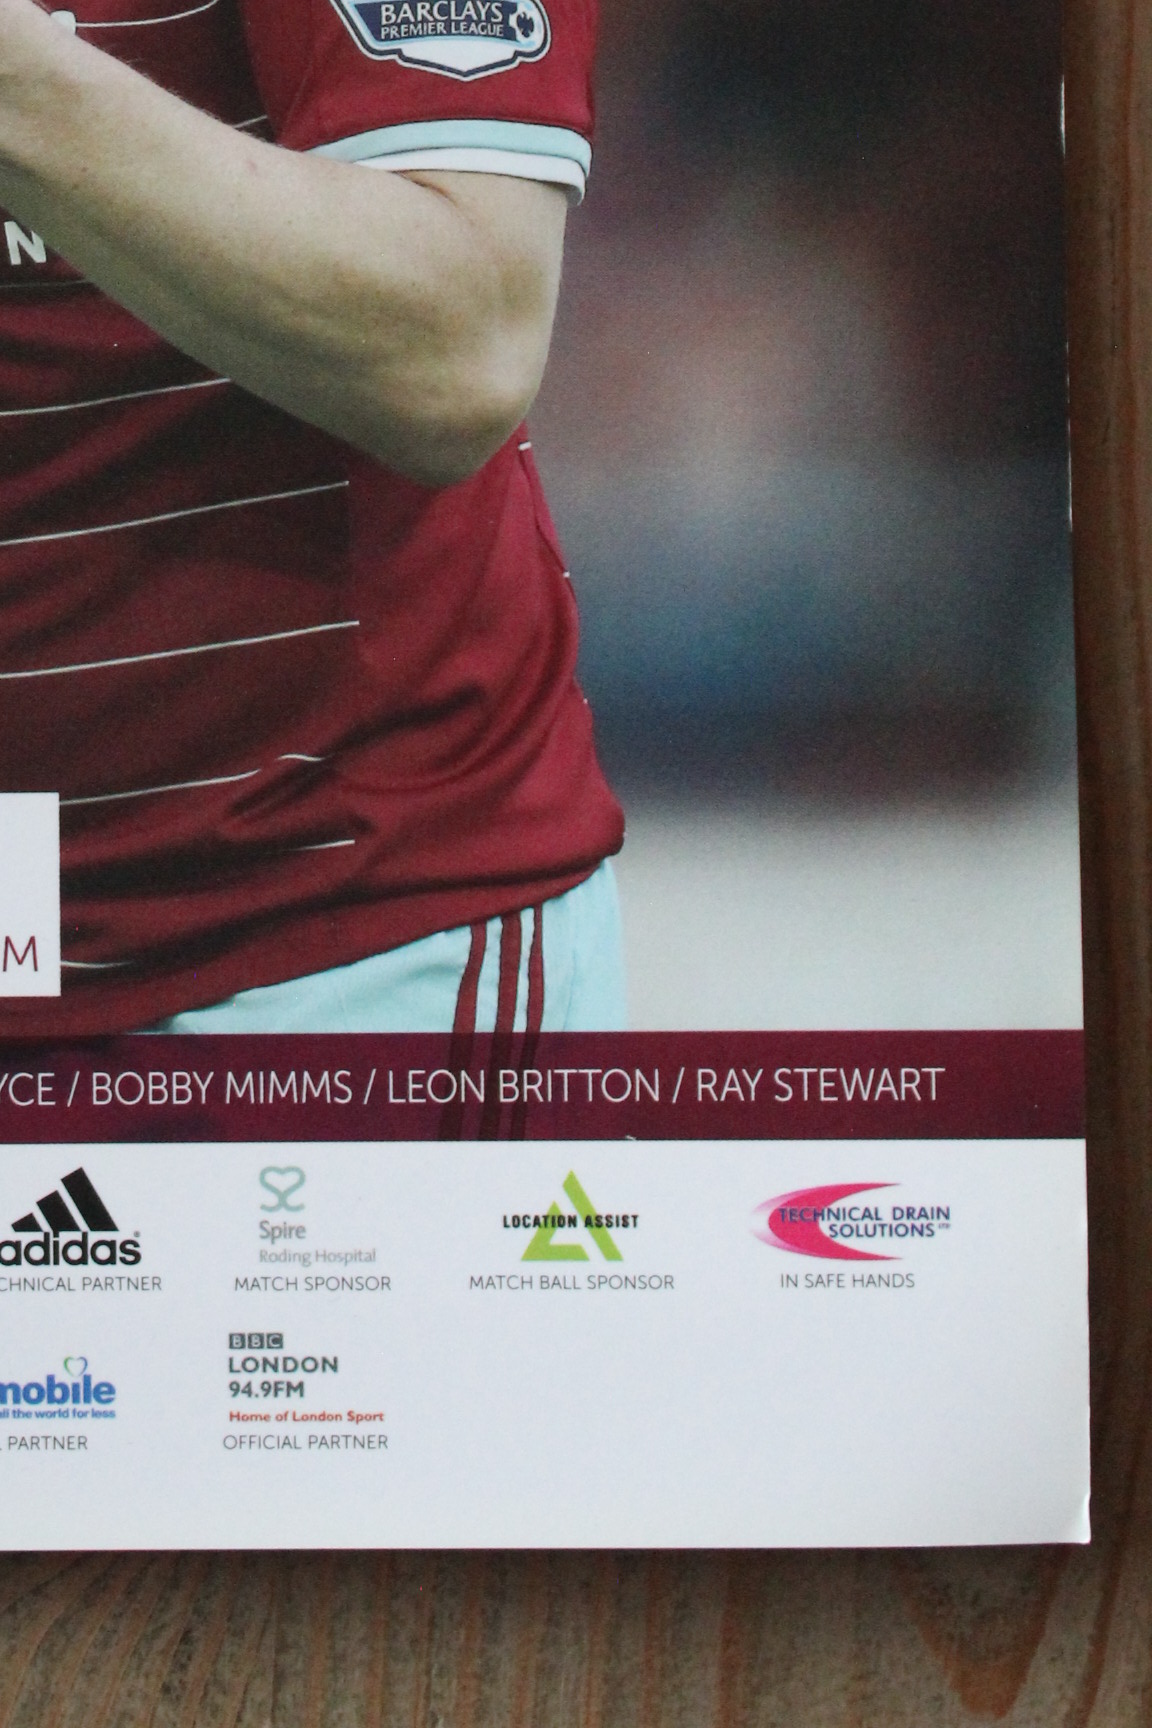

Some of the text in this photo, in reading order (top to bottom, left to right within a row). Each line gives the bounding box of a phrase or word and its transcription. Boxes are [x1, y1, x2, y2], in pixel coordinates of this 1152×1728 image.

[380, 0, 503, 26] BARCLAYS
[380, 22, 504, 40] PREMIER LEAGUE
[67, 1071, 79, 1107] /
[92, 1071, 213, 1106] BOBBY
[225, 1070, 352, 1105] MIMMS
[363, 1070, 377, 1105] /
[388, 1069, 485, 1104] LEON
[499, 1068, 663, 1103] BRITTON
[671, 1068, 686, 1103] /
[697, 1068, 763, 1102] RAY
[774, 1067, 945, 1102] STEWART
[503, 1215, 639, 1228] LOCATION ASSIST
[778, 1206, 950, 1222] TECHNICAL DRAIN
[259, 1220, 306, 1244] Spire
[828, 1223, 935, 1238] SOLUTIONS
[259, 1248, 376, 1267] Roding Hospital
[82, 1276, 162, 1292] PARTNER
[234, 1276, 391, 1291] MATCH SPONSOR
[469, 1275, 675, 1290] MATCH BALL SPONSOR
[780, 1273, 915, 1288] IN SAFE HANDS
[229, 1333, 284, 1350] BBC
[228, 1356, 339, 1373] LONDON
[229, 1380, 305, 1398] 94.9FM
[12, 1408, 32, 1418] the
[35, 1408, 70, 1418] world
[72, 1408, 89, 1418] for
[91, 1408, 116, 1418] less
[229, 1410, 384, 1425] Home of London Sport
[8, 1436, 88, 1450] PARTNER
[223, 1434, 388, 1450] OFFICIAL PARTNER
